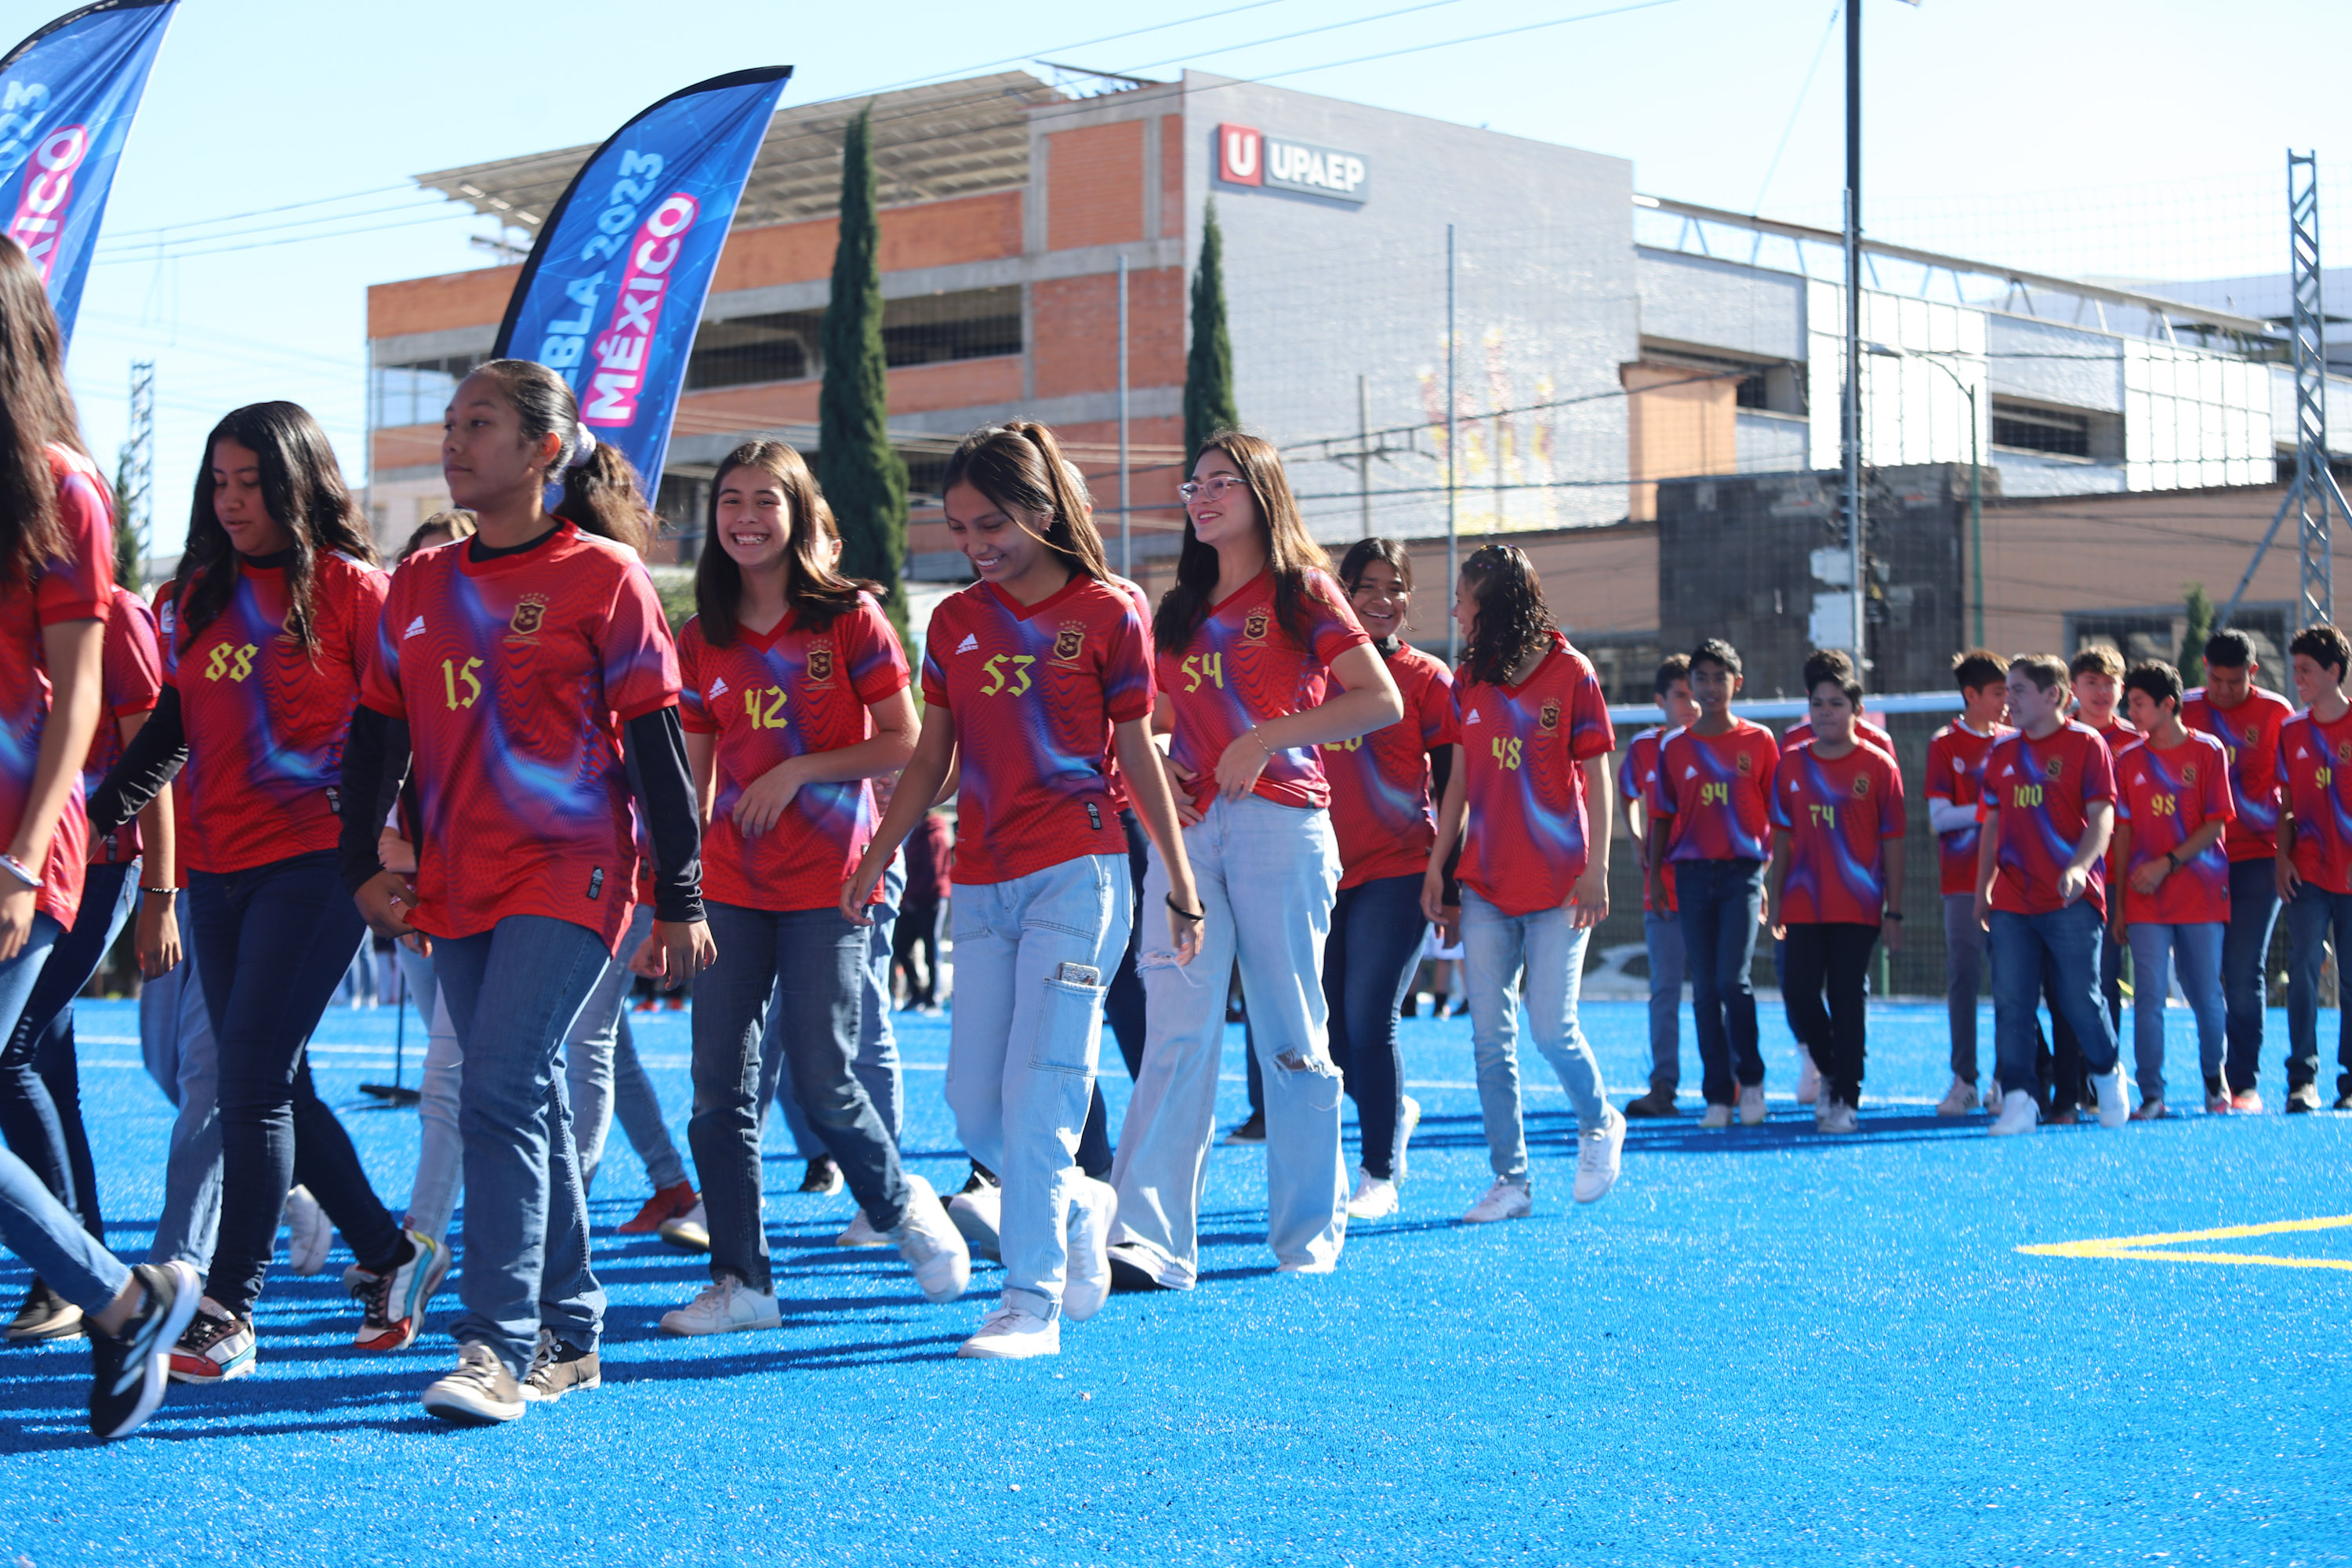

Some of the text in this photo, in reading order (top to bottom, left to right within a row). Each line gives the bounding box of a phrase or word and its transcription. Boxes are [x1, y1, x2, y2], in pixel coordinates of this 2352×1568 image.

[1227, 132, 1366, 192] U UPAEP
[581, 150, 664, 261] 2023
[586, 198, 695, 419] MÉXICO
[205, 642, 260, 683] 88
[441, 655, 485, 711] 15
[980, 653, 1036, 697] 53
[1181, 652, 1224, 693] 54
[745, 684, 788, 730] 42
[1492, 736, 1523, 771] 48
[1701, 782, 1728, 806] 94
[2013, 783, 2042, 808] 100
[1809, 804, 1835, 829] 74
